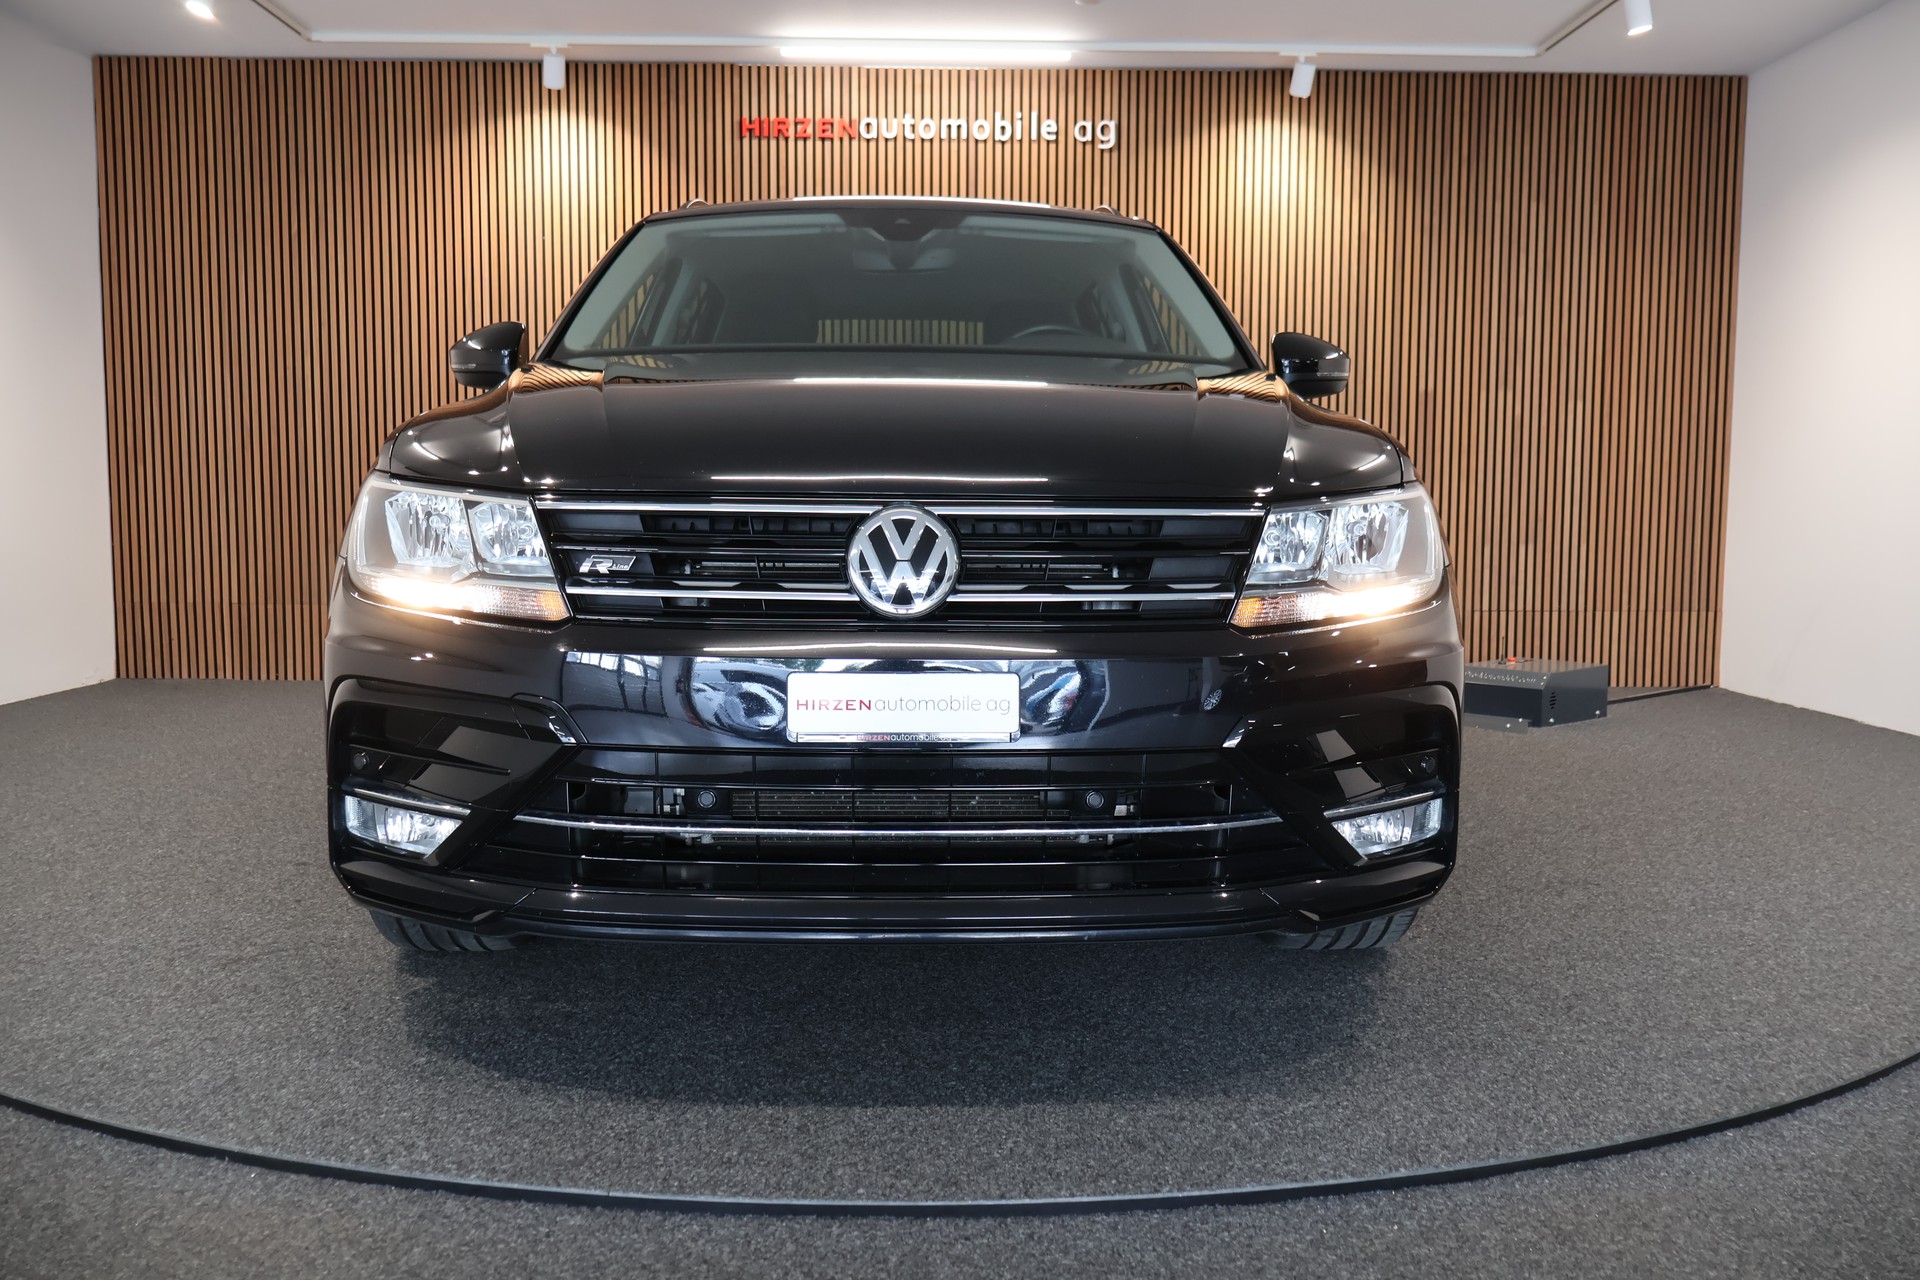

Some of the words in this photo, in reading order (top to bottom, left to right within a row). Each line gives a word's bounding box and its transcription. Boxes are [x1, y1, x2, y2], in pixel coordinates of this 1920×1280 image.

[740, 111, 1058, 142] HIRZENautomobile
[1073, 118, 1117, 150] ag
[796, 695, 981, 712] HIRZENautomobile
[986, 699, 1011, 715] ag
